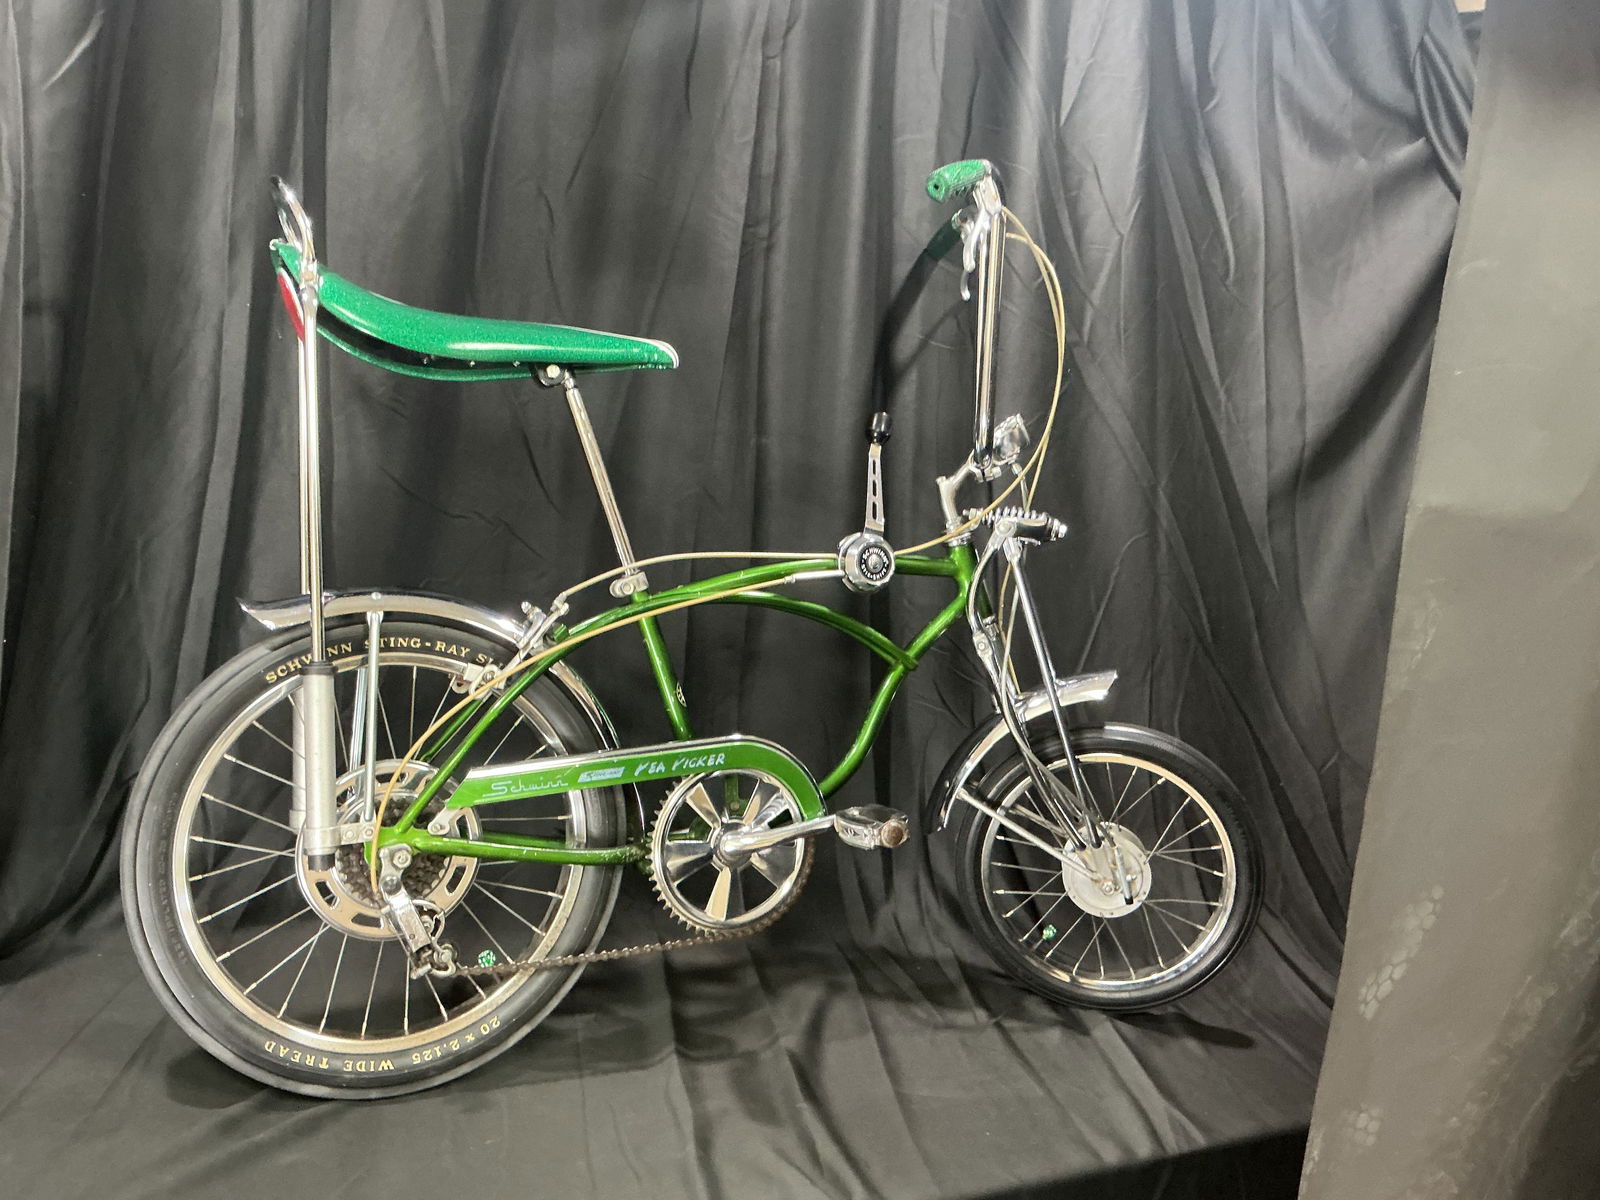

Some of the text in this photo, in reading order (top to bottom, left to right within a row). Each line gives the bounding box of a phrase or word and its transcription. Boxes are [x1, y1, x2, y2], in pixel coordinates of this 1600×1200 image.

[265, 642, 352, 684] SCHWNN
[482, 777, 568, 797] Schwinn
[480, 1015, 500, 1035] 20
[264, 1041, 329, 1069] TREAD
[412, 1039, 460, 1065] 2.125
[343, 1060, 395, 1072] WIDE
